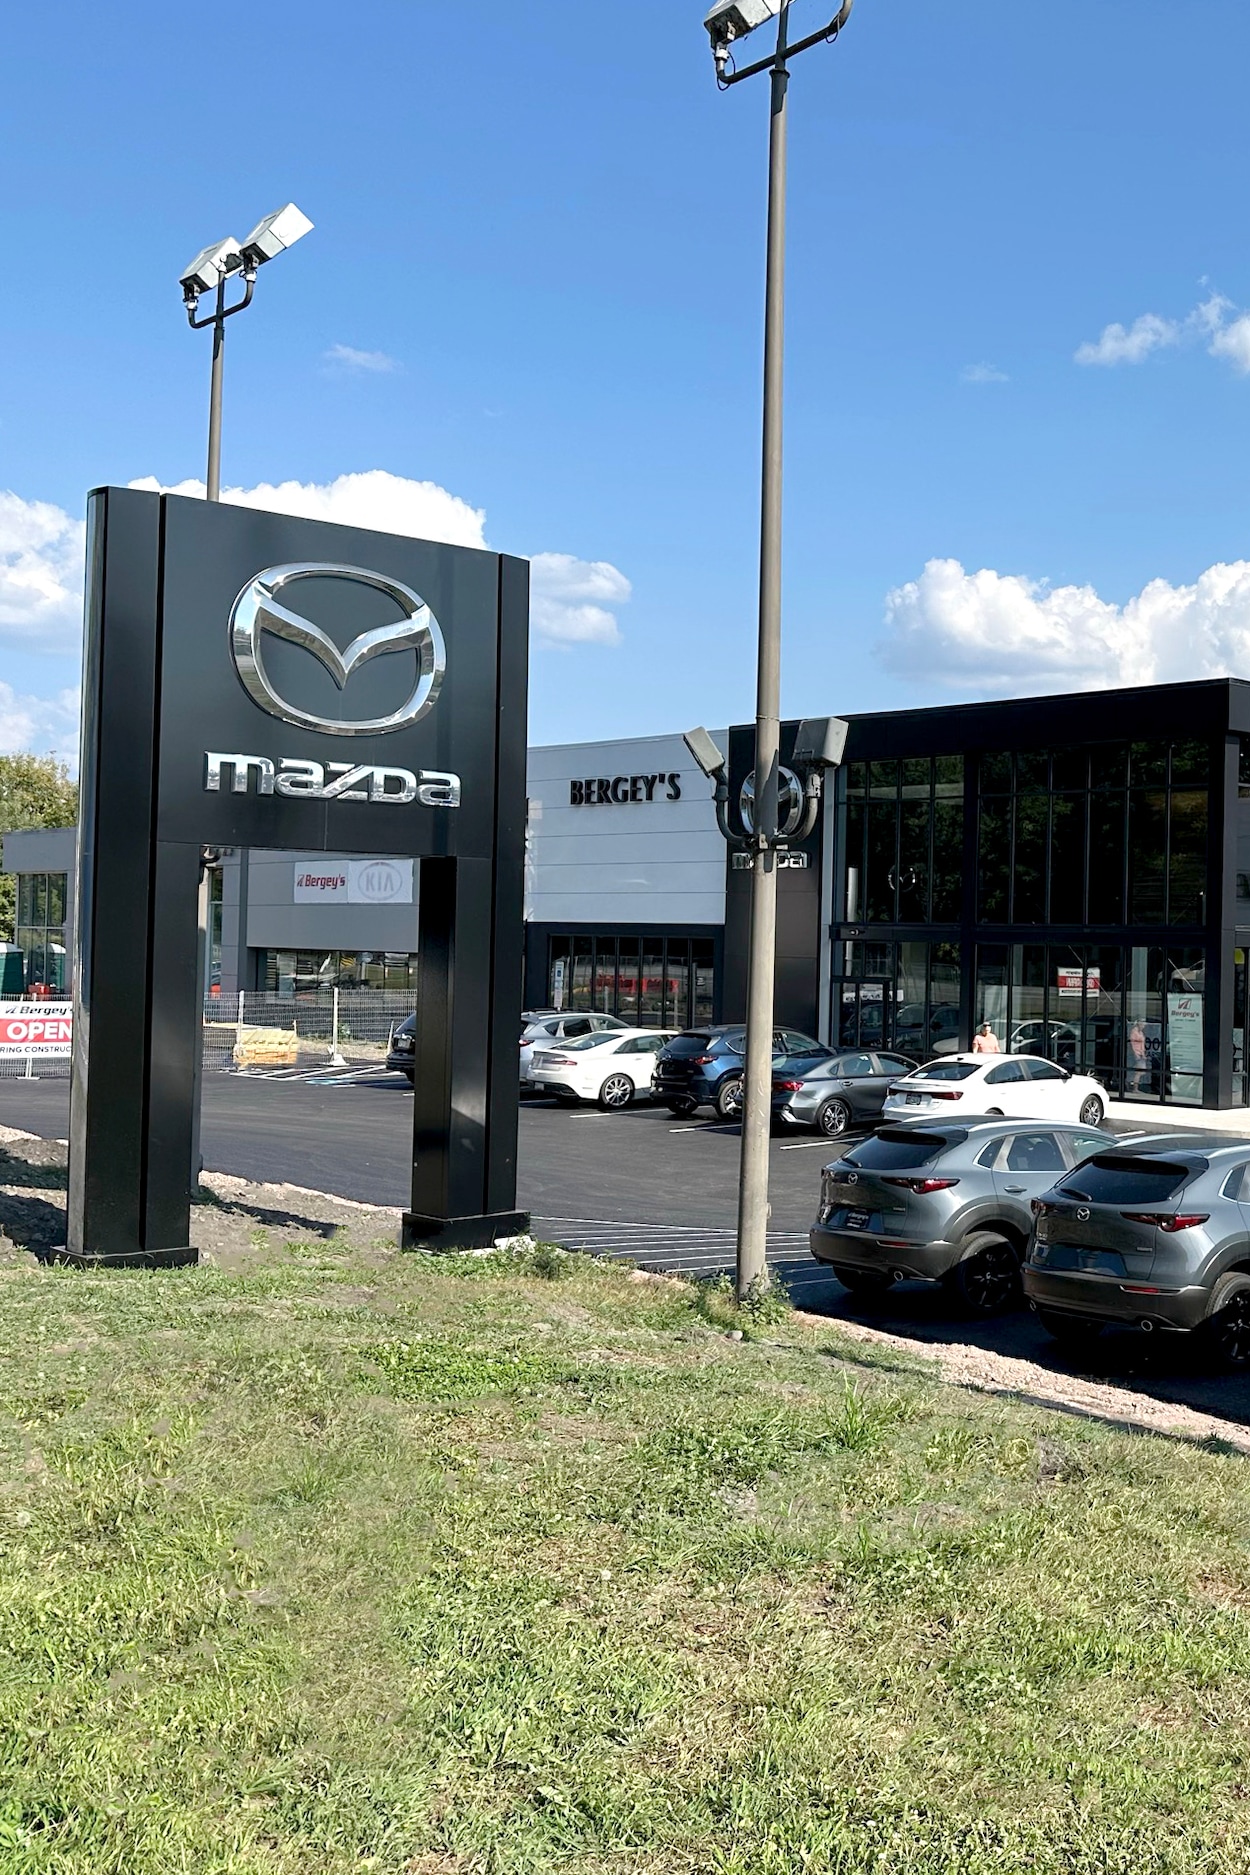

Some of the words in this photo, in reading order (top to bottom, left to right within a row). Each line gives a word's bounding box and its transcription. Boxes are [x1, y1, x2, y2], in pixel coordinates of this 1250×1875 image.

[570, 773, 681, 805] BERGEY'S
[305, 874, 346, 890] Bergey's
[366, 871, 395, 892] KIA
[20, 1006, 73, 1016] Bergey'
[7, 1021, 73, 1040] OPEN
